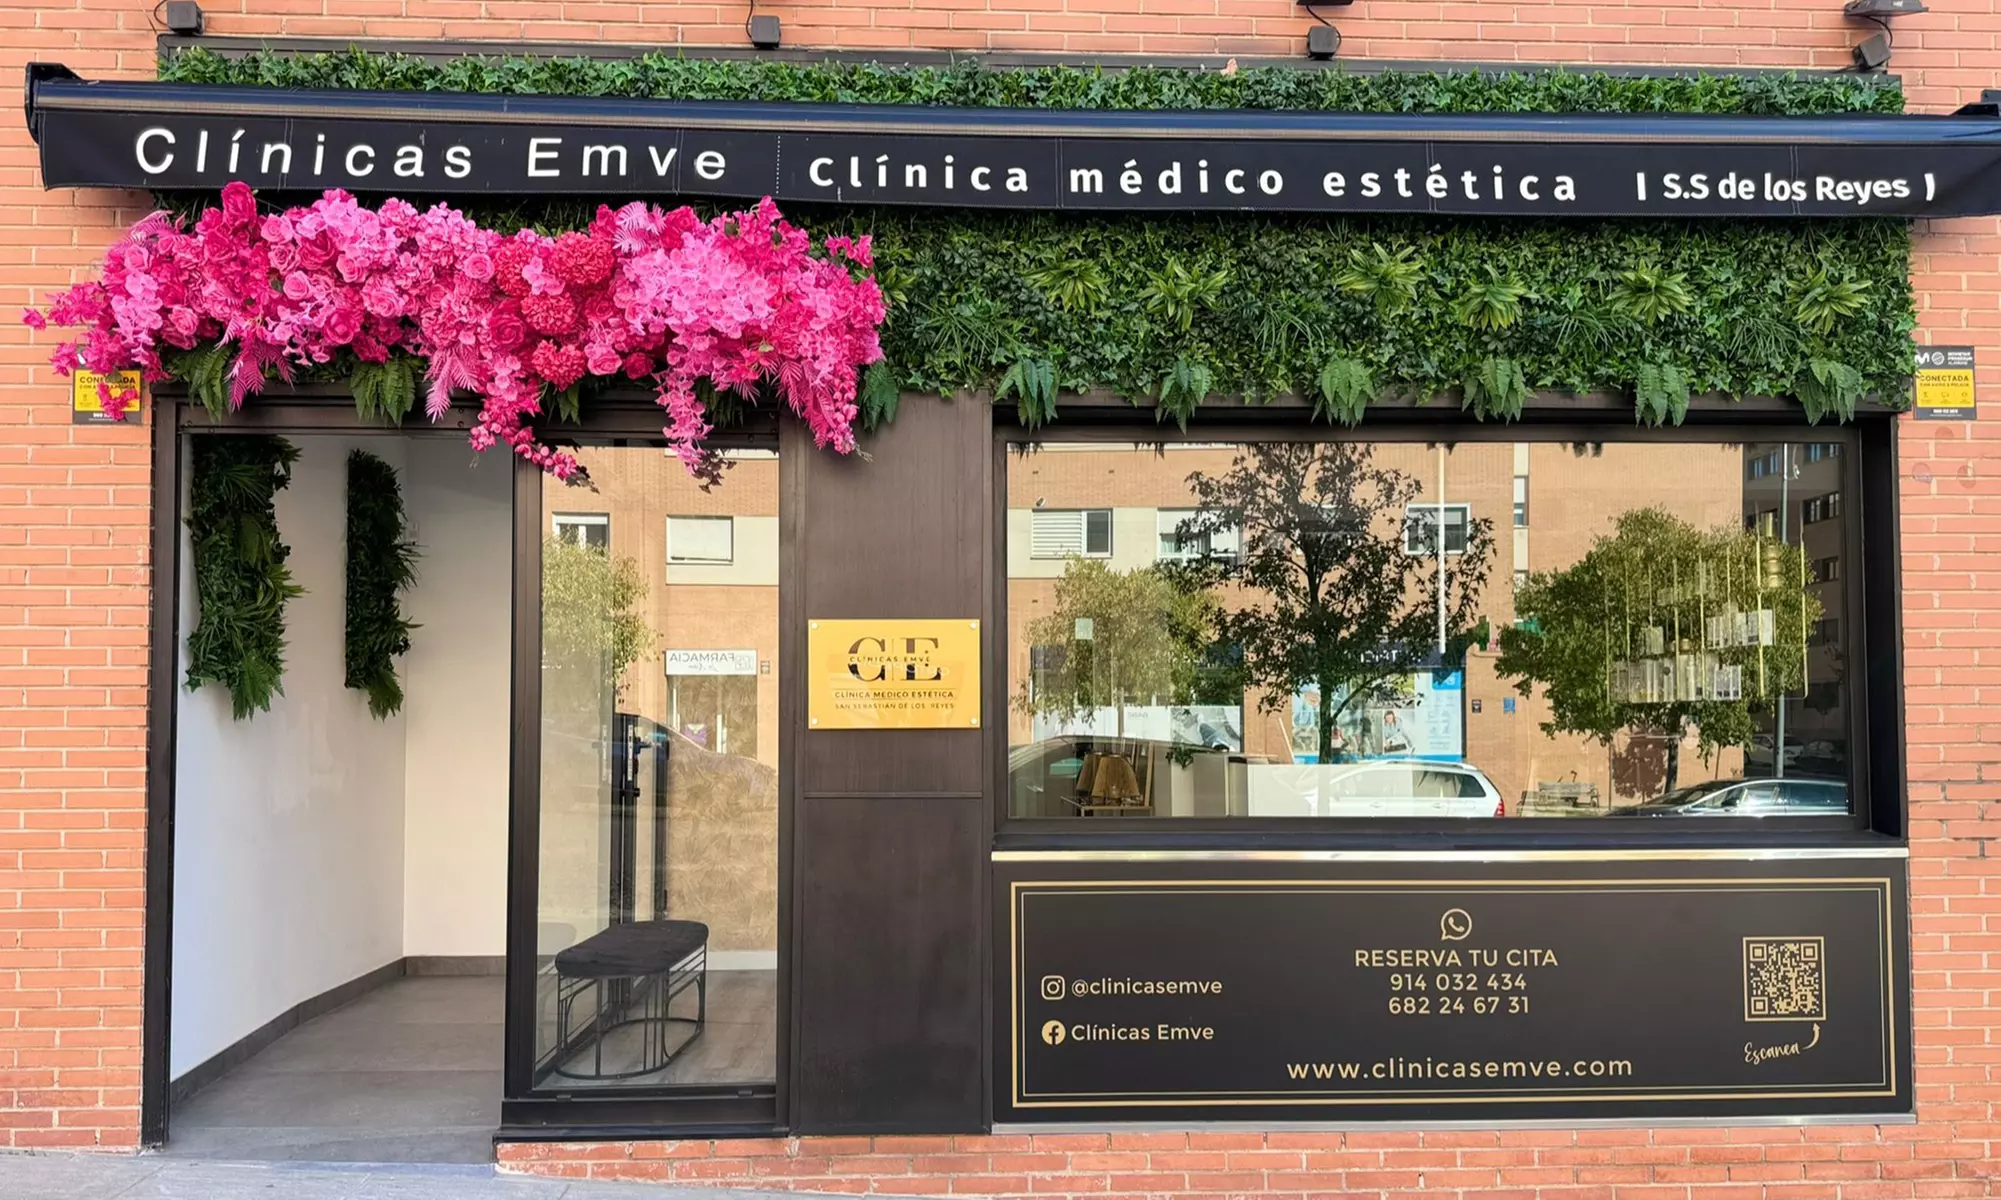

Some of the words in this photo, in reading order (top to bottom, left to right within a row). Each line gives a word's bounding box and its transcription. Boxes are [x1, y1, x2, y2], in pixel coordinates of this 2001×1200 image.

[135, 127, 471, 179] Clínicas
[527, 137, 727, 181] Emve
[809, 154, 1029, 193] Clínica
[1069, 159, 1284, 197] médico
[1323, 163, 1577, 202] estética
[1663, 173, 1710, 200] S.S
[1718, 172, 1756, 200] de
[1764, 172, 1808, 202] los
[1815, 175, 1911, 206] Reyes
[1355, 949, 1462, 967] RESERVA
[1467, 949, 1498, 967] TU
[1506, 948, 1560, 967] CITA
[1071, 977, 1223, 998] @clinicasemve
[1390, 973, 1427, 991] 914
[1435, 973, 1478, 991] 032
[1486, 972, 1528, 990] 434
[1388, 996, 1431, 1015] 682
[1439, 996, 1467, 1015] 24
[1473, 996, 1501, 1014] 67
[1508, 996, 1530, 1014] 31
[1071, 1023, 1151, 1041] Clínicas
[1157, 1024, 1214, 1040] Emve
[1743, 1041, 1800, 1065] Escanea
[1287, 1056, 1633, 1079] www.clinicasemve.com
